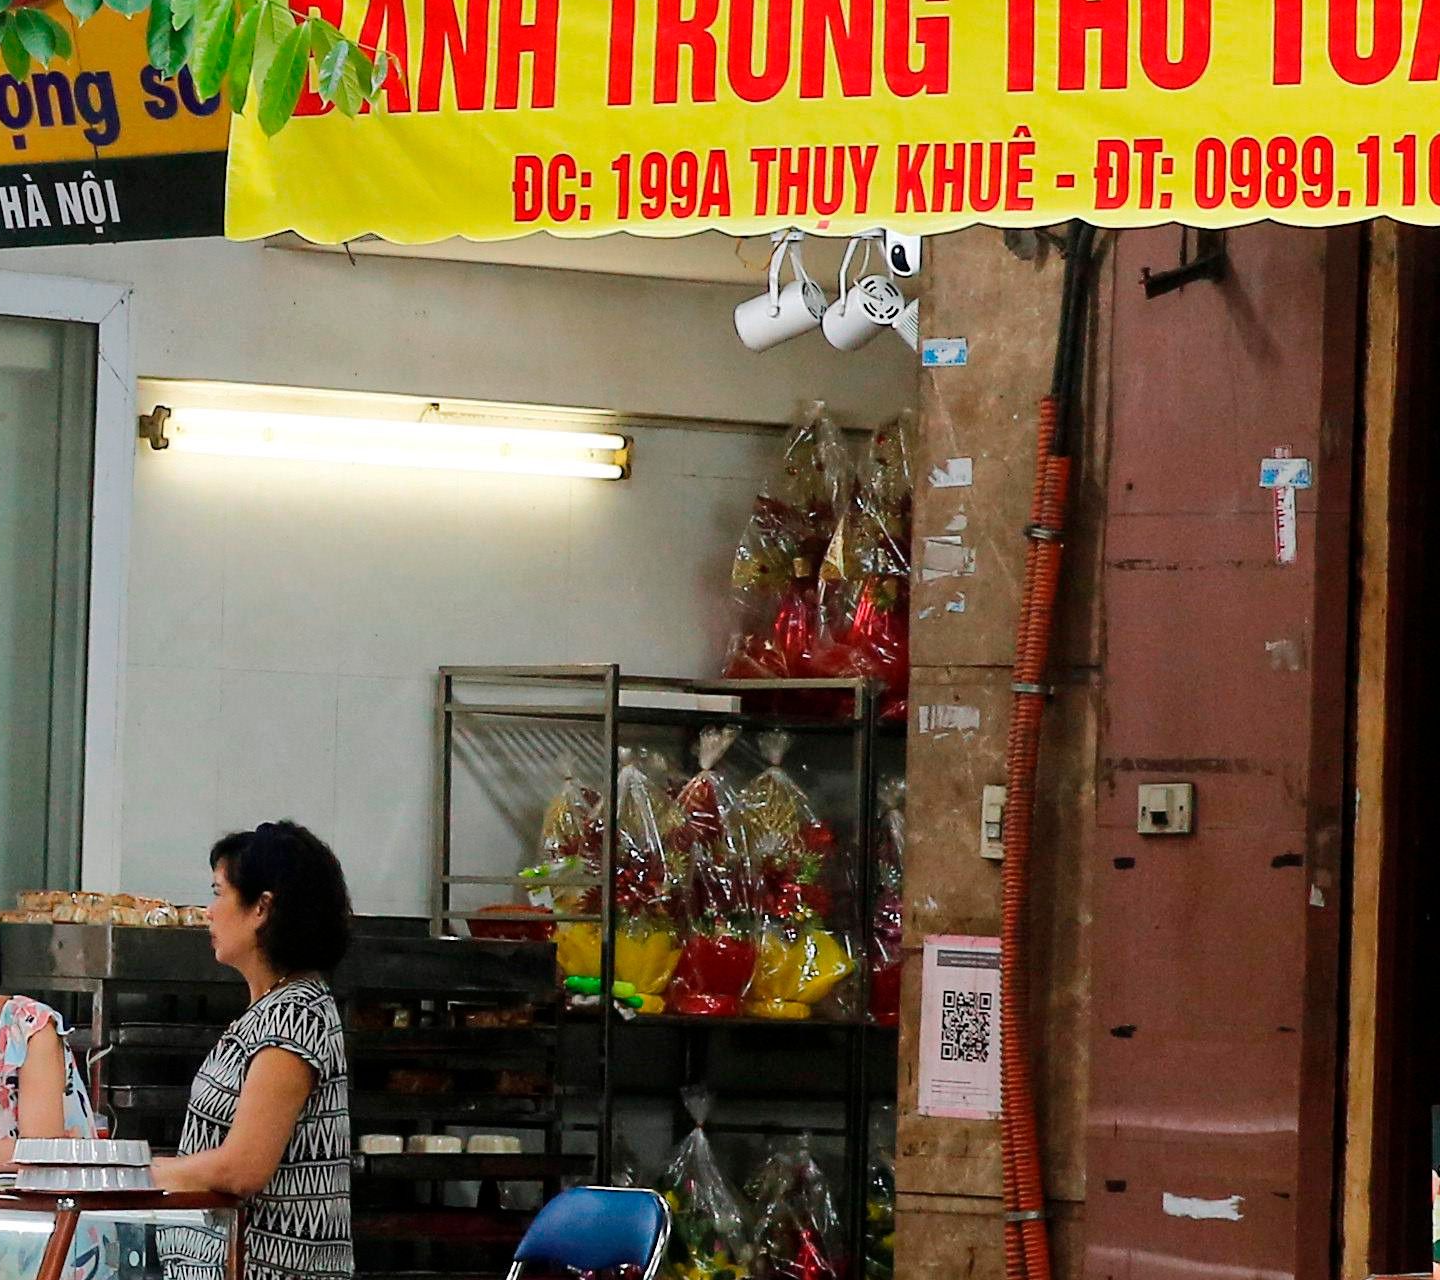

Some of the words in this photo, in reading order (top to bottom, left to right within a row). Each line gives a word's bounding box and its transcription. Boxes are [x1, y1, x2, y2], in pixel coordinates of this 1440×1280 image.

[0, 177, 49, 230] HÀ
[54, 169, 122, 236] NỘI
[512, 152, 593, 223] ĐC:
[611, 147, 732, 221] 199A
[750, 141, 880, 231] THỤY
[894, 124, 1036, 217] KHUÊ
[1093, 135, 1174, 212] ĐT:
